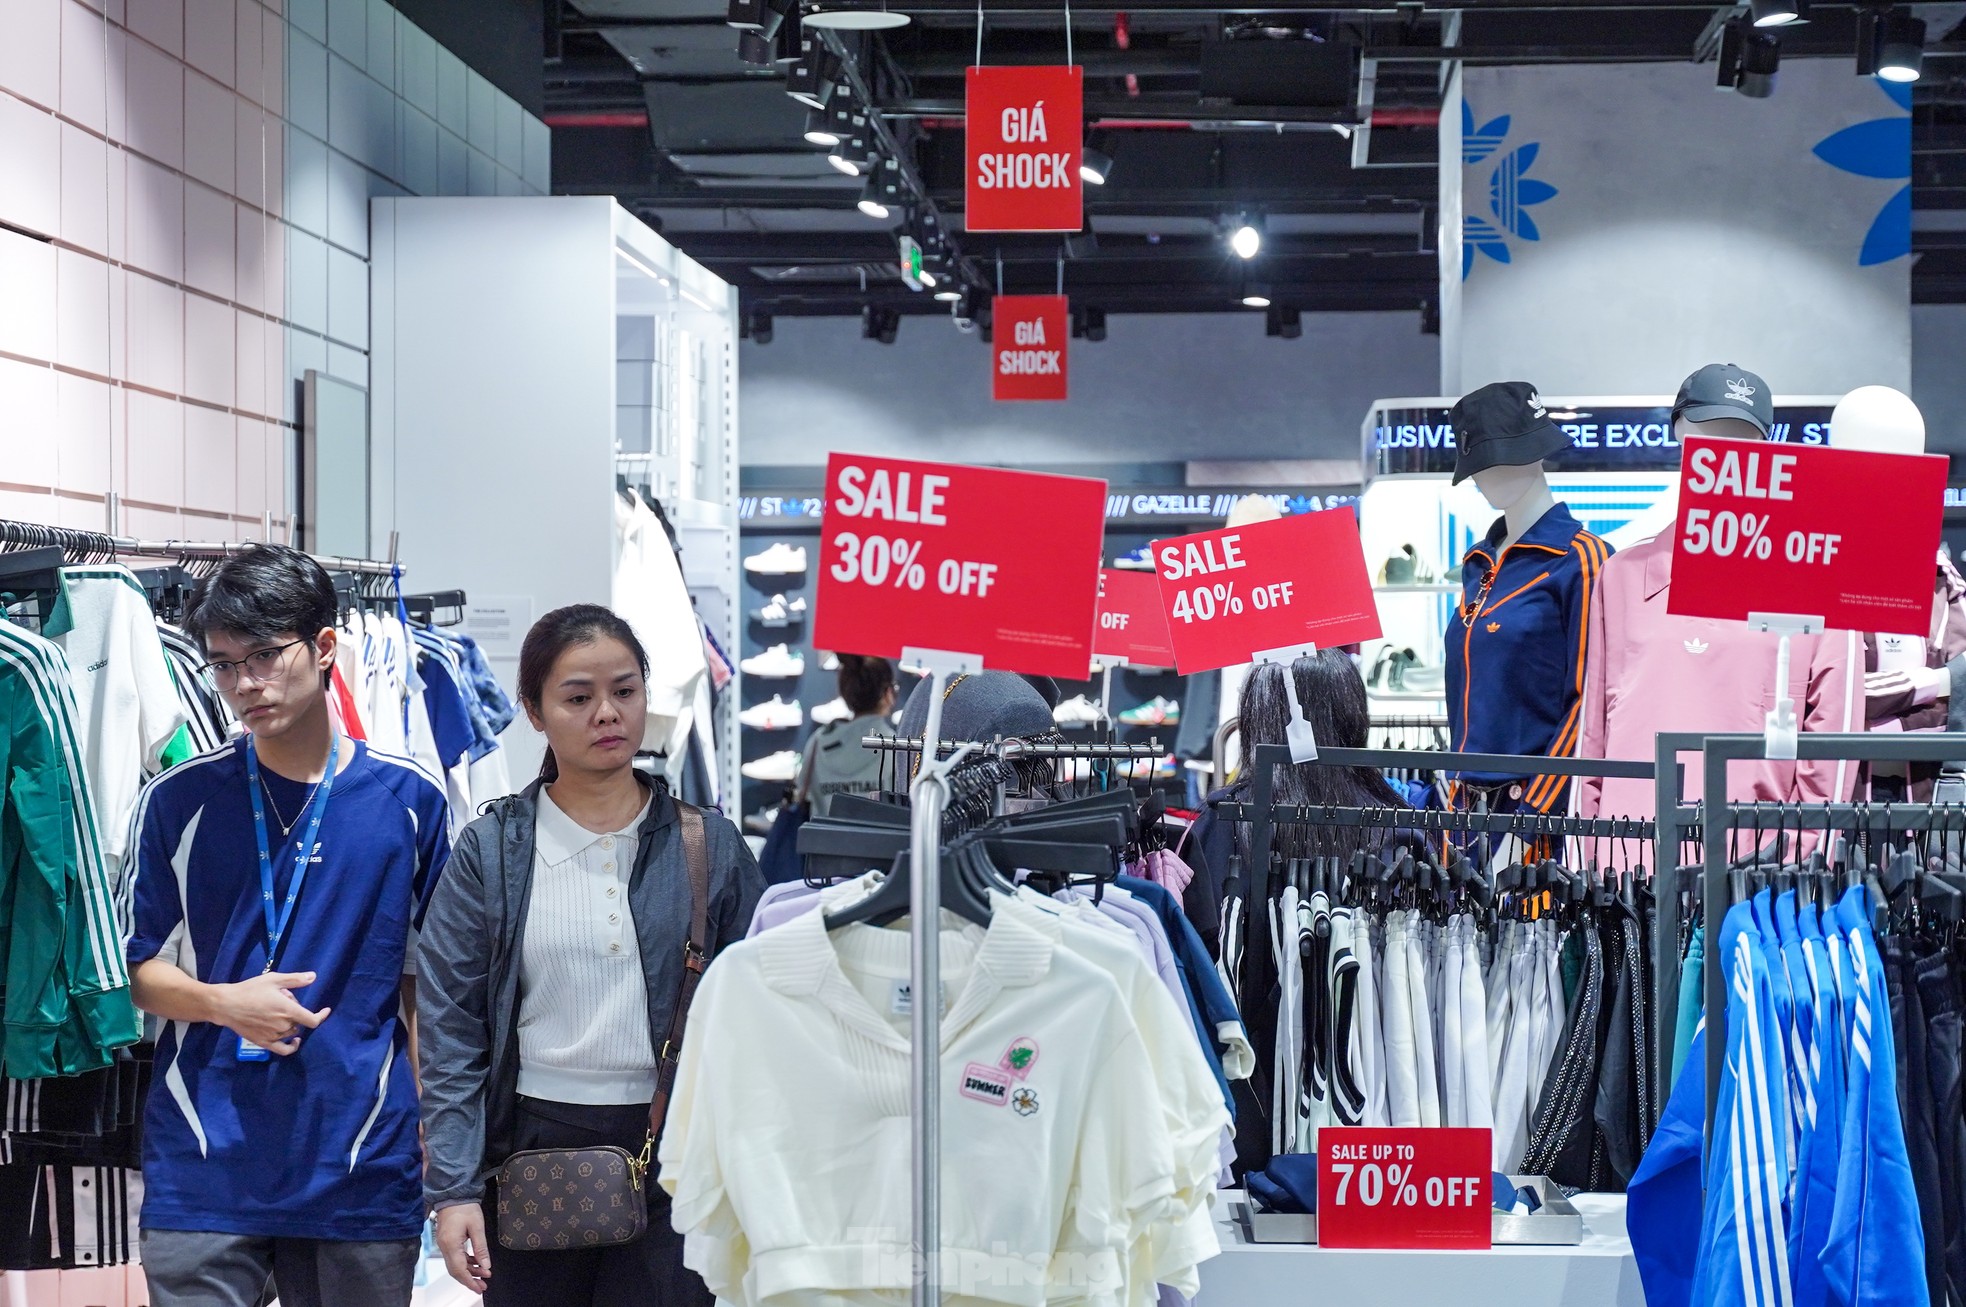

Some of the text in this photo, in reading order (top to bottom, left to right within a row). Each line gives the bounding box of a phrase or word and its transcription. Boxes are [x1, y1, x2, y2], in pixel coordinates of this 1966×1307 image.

[1001, 101, 1048, 143] GIÁ
[977, 153, 1072, 189] SHOCK
[1015, 317, 1046, 346] GIÁ
[999, 350, 1061, 376] SHOCK
[1687, 446, 1798, 502] SALE
[835, 466, 950, 526] SALE
[1160, 533, 1247, 581] SALE
[1680, 508, 1842, 566] 50% OFF
[830, 531, 998, 601] 30% OFF
[1100, 611, 1130, 631] OFF
[1172, 581, 1296, 624] 40% OFF
[965, 1077, 1006, 1098] SUMMER
[1331, 1144, 1415, 1160] SALE UP TO
[1331, 1163, 1480, 1207] 70% OFF
